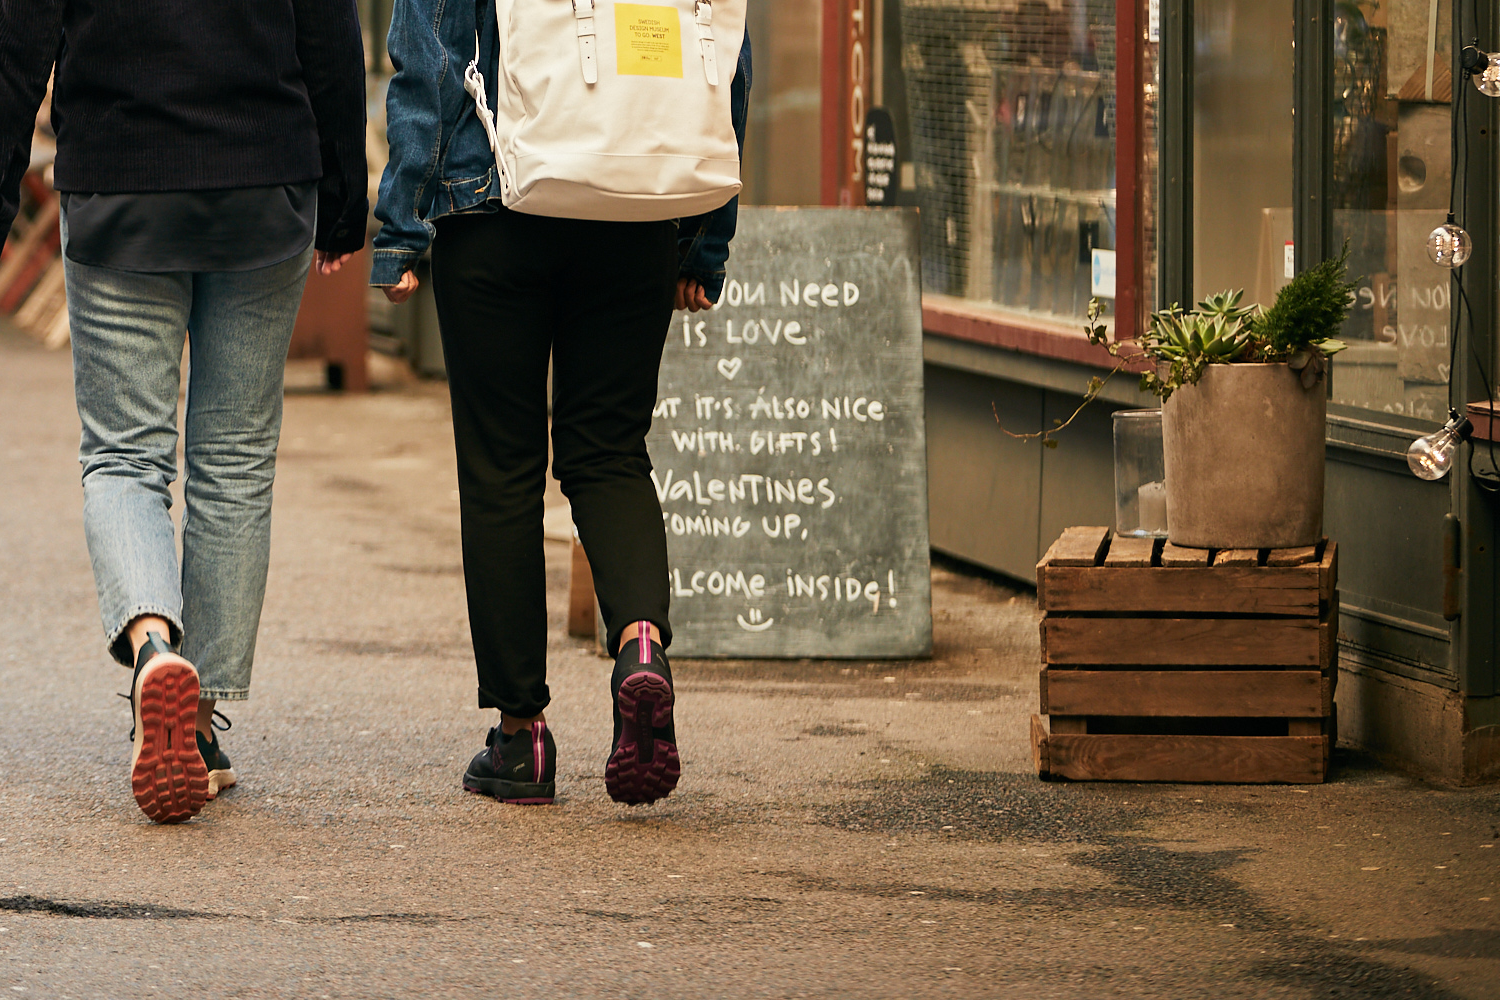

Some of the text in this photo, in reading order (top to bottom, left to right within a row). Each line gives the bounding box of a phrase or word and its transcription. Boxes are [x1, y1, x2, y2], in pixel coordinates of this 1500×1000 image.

[779, 278, 860, 308] NeeD
[682, 315, 807, 348] iS LOVe
[652, 397, 681, 420] uT
[821, 396, 885, 423] NICe
